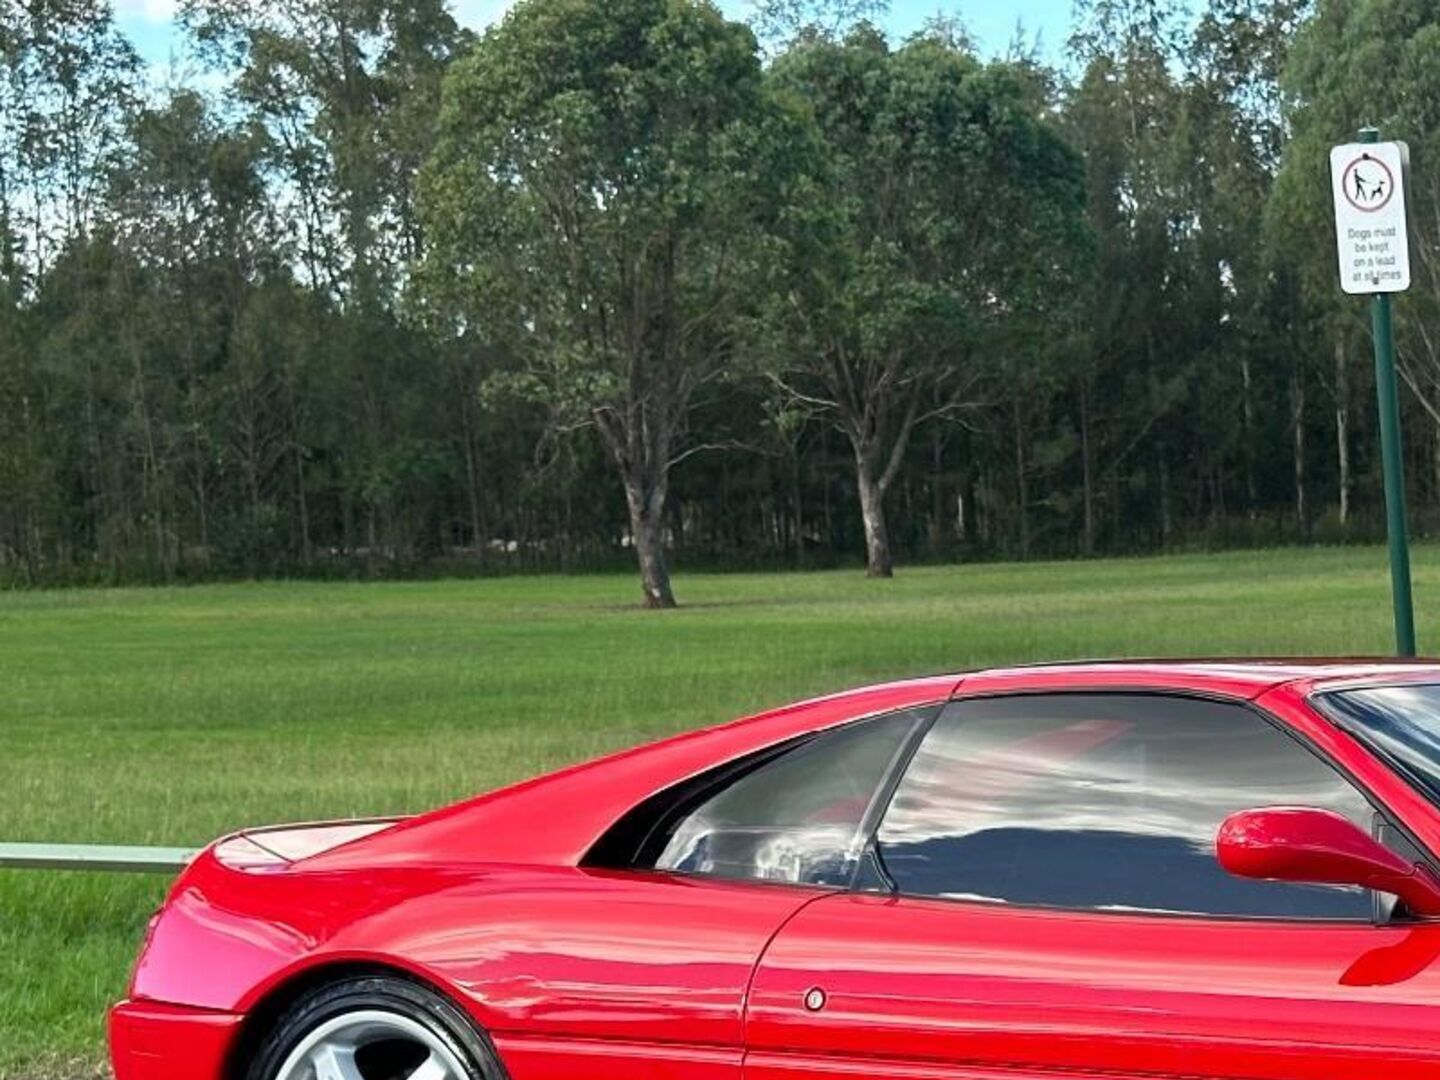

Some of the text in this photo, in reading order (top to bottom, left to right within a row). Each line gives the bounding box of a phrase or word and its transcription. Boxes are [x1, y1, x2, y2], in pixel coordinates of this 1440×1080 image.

[1348, 227, 1396, 241] Dogs must
[1354, 242, 1389, 253] be kept
[1353, 256, 1395, 267] on a lead
[1353, 272, 1361, 281] at
[1376, 271, 1401, 280] times
